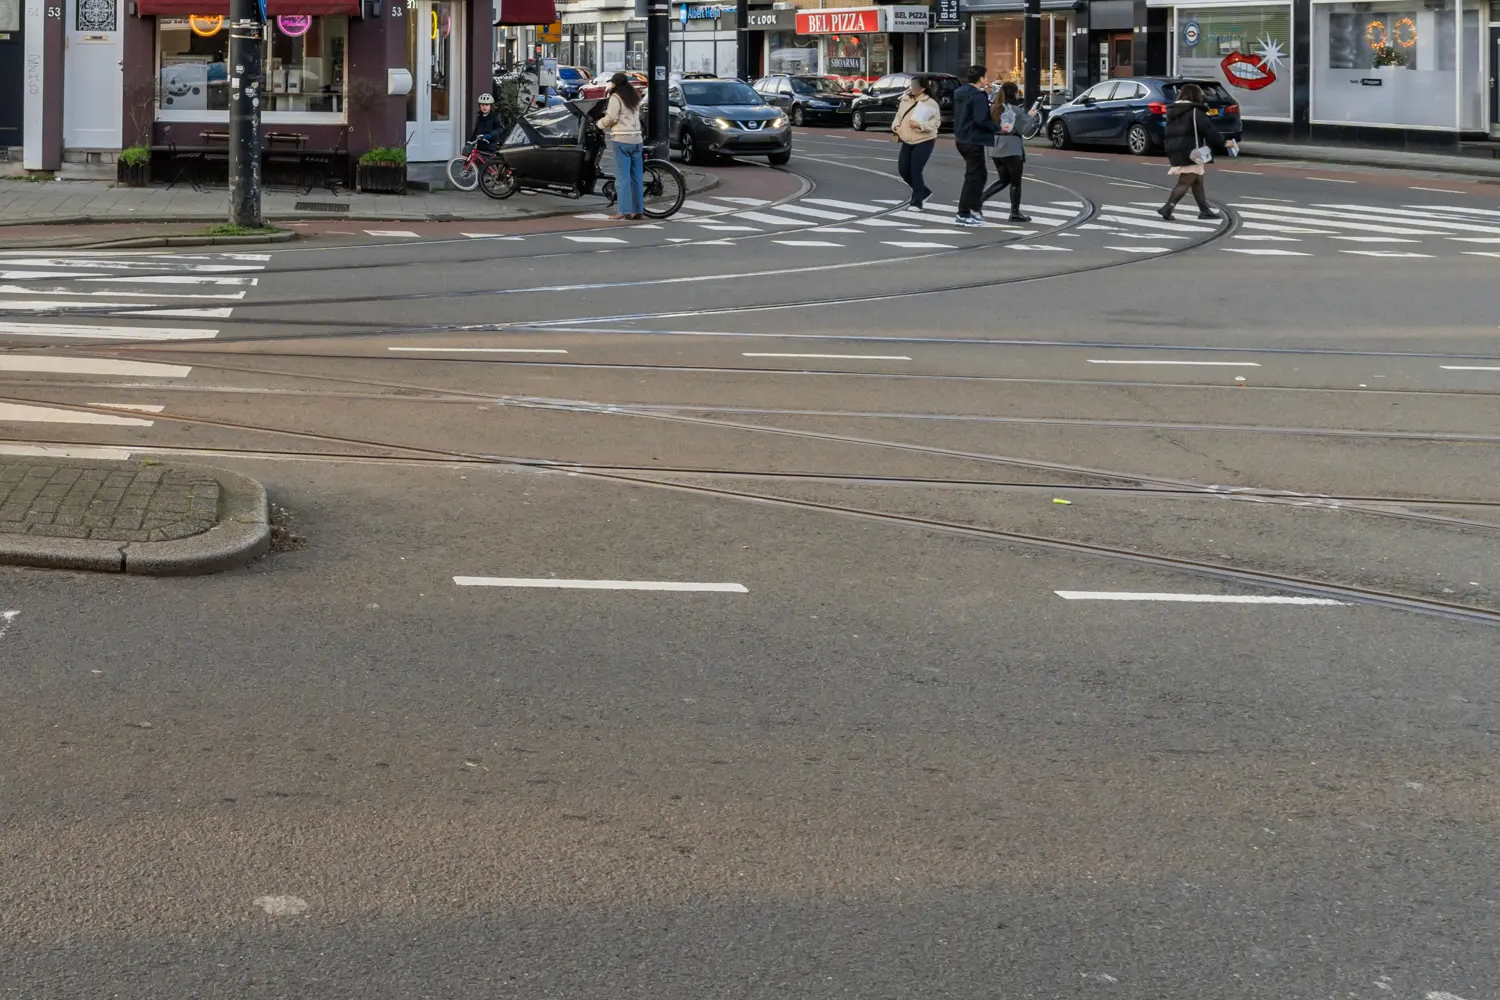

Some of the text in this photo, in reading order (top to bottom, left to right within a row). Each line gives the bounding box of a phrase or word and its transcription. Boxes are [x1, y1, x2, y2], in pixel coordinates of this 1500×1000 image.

[688, 6, 705, 18] Albert
[758, 15, 777, 25] LOOK
[808, 12, 866, 32] BEL PIZZA
